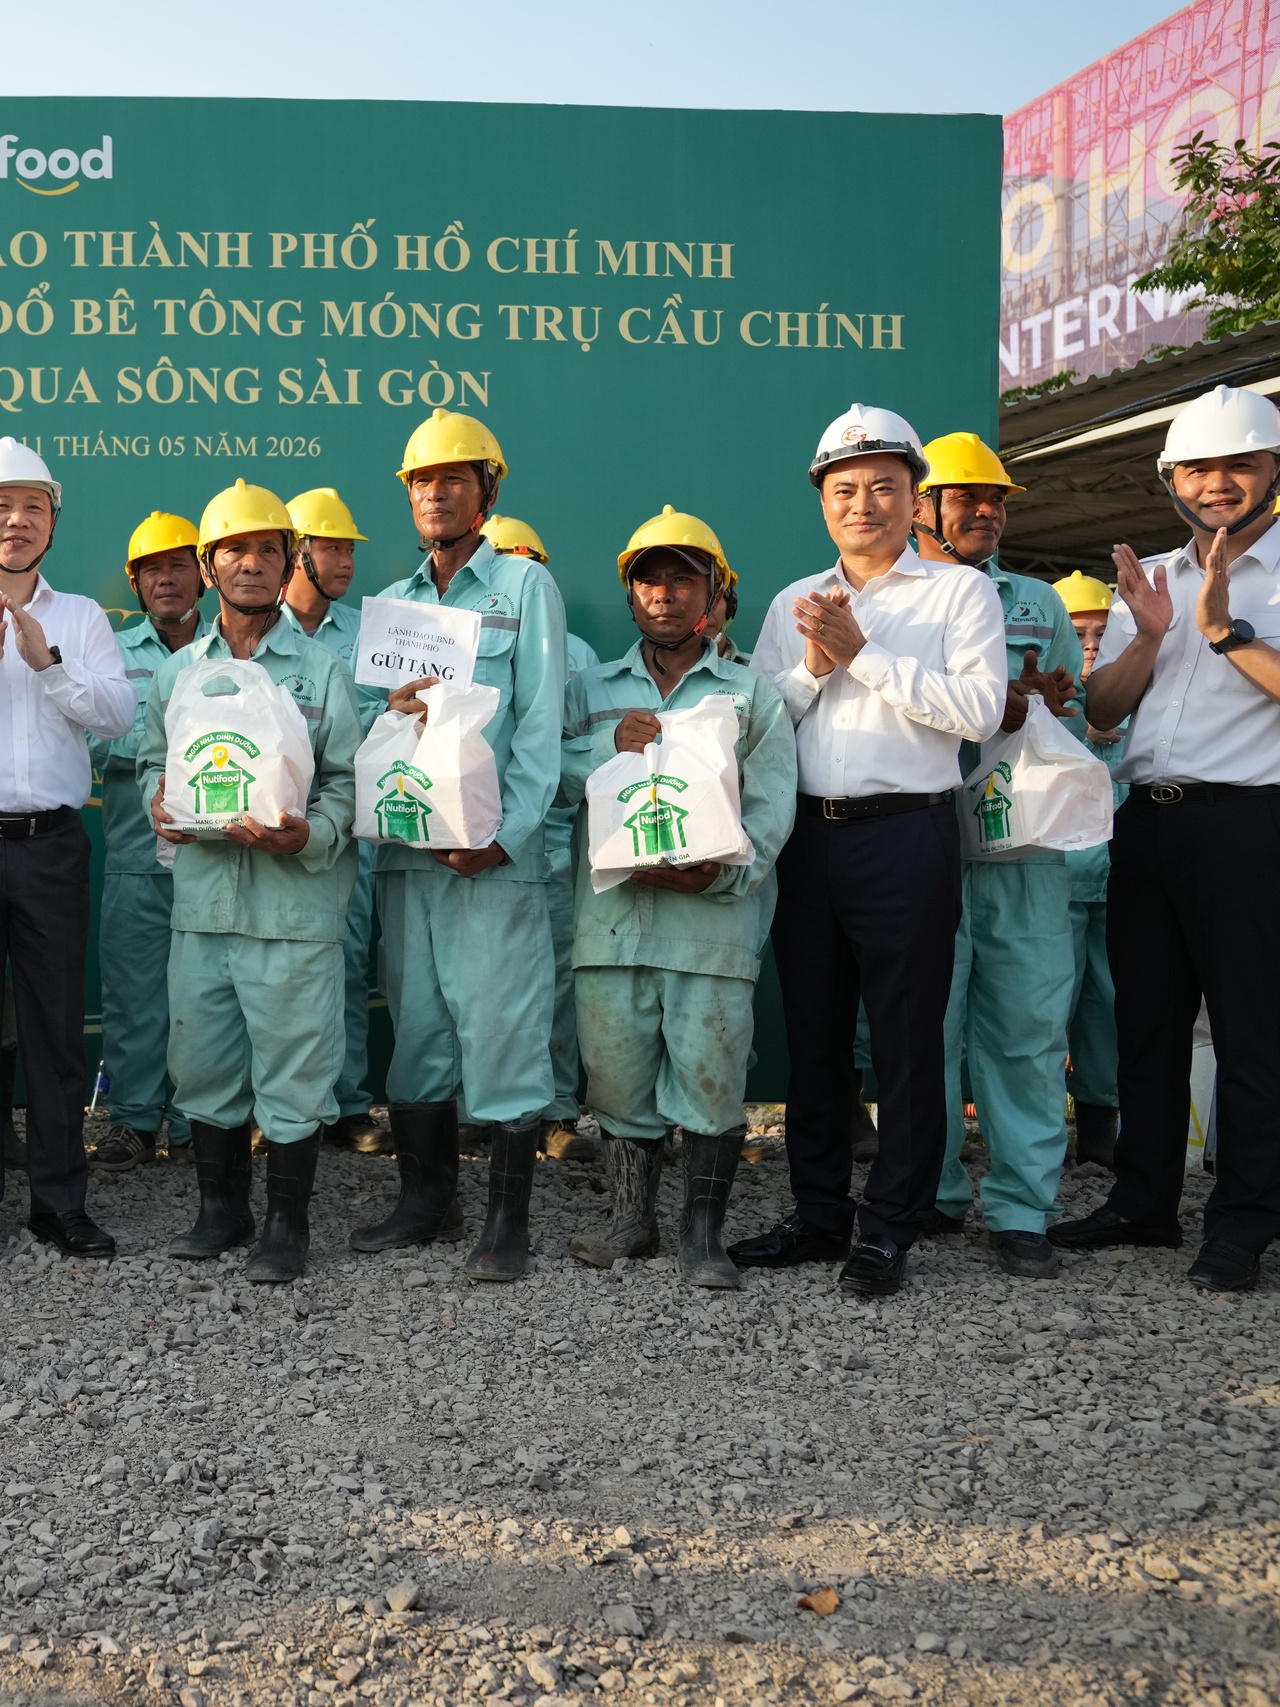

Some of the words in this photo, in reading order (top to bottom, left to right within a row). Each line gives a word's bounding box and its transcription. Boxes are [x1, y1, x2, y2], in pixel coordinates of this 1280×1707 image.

[64, 221, 253, 268] THÀNH
[268, 219, 378, 270] PHỐ
[394, 221, 470, 272] HỒ
[487, 229, 579, 275] CHÍ
[595, 240, 735, 279] MINH
[70, 288, 137, 335] BÊ
[154, 288, 305, 336] TÔNG
[320, 292, 484, 339] MÓNG
[499, 304, 602, 352] TRỤ
[619, 293, 725, 345] CẦU
[739, 303, 905, 349] CHÍNH
[118, 356, 262, 404] SÔNG
[279, 358, 363, 404] SÀI
[378, 360, 492, 407] GÒN
[54, 430, 151, 456] THÁNG
[159, 436, 185, 457] 05
[194, 432, 258, 456] NĂM
[266, 436, 321, 457] 2026
[388, 626, 411, 636] LÃNH
[413, 631, 430, 641] ĐẠO
[431, 634, 455, 646] UBND
[395, 637, 421, 648] THÀNH
[371, 651, 404, 670] GỬI
[408, 658, 455, 681] TẶNG
[200, 734, 215, 746] NHÀ
[216, 734, 234, 742] DINH
[203, 773, 239, 785] Nutifood
